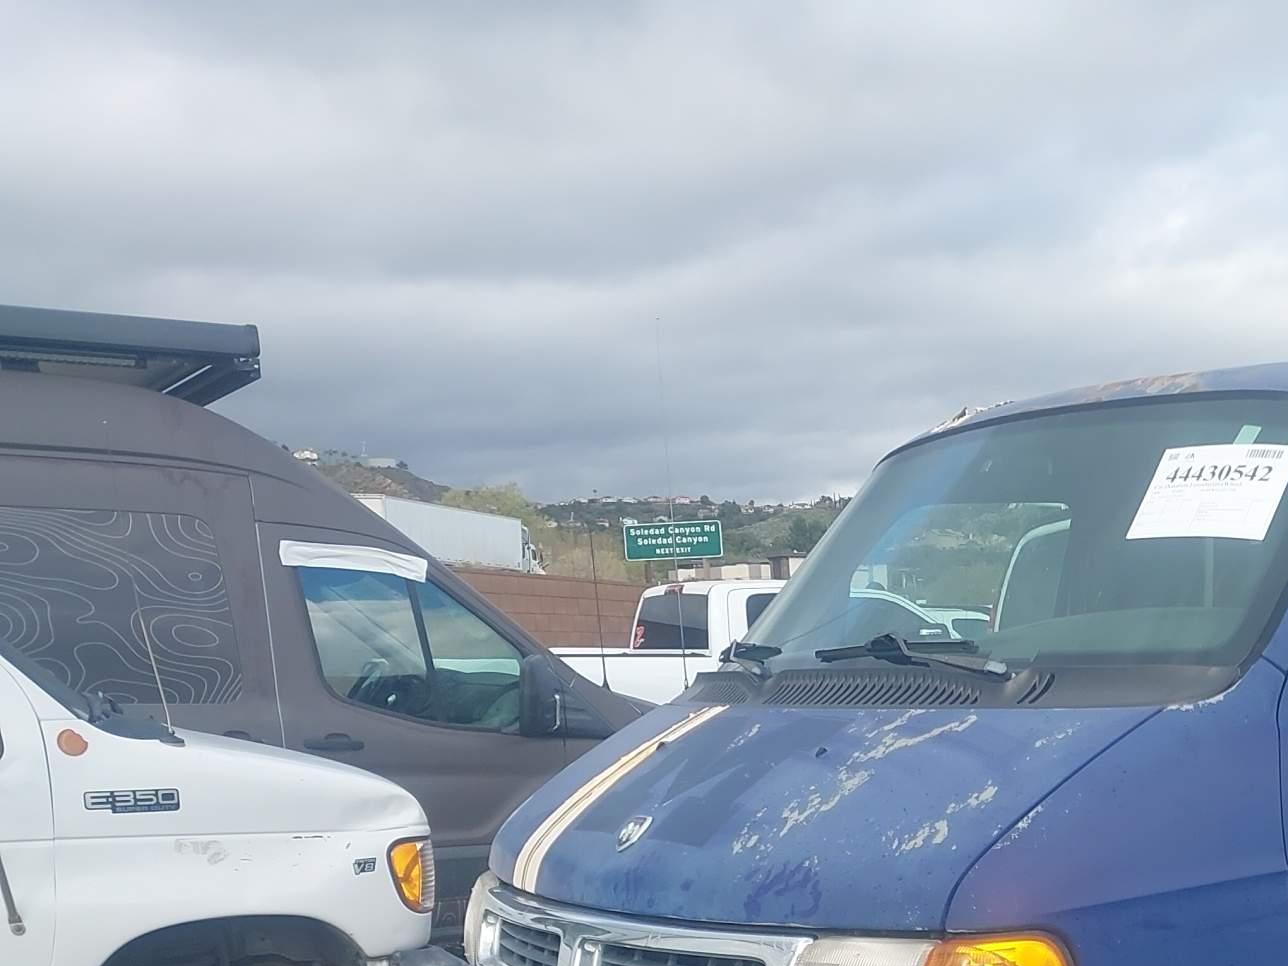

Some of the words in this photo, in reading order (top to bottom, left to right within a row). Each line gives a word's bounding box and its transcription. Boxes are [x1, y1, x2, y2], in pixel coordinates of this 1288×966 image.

[1166, 464, 1273, 483] 44430542
[629, 527, 665, 536] Soledad
[668, 526, 701, 536] Canyon
[704, 524, 716, 532] Rd
[637, 536, 673, 545] Soledad
[676, 535, 709, 544] Canyon
[655, 547, 673, 555] NEXT
[676, 546, 692, 554] EXIT
[353, 862, 375, 875] V8
